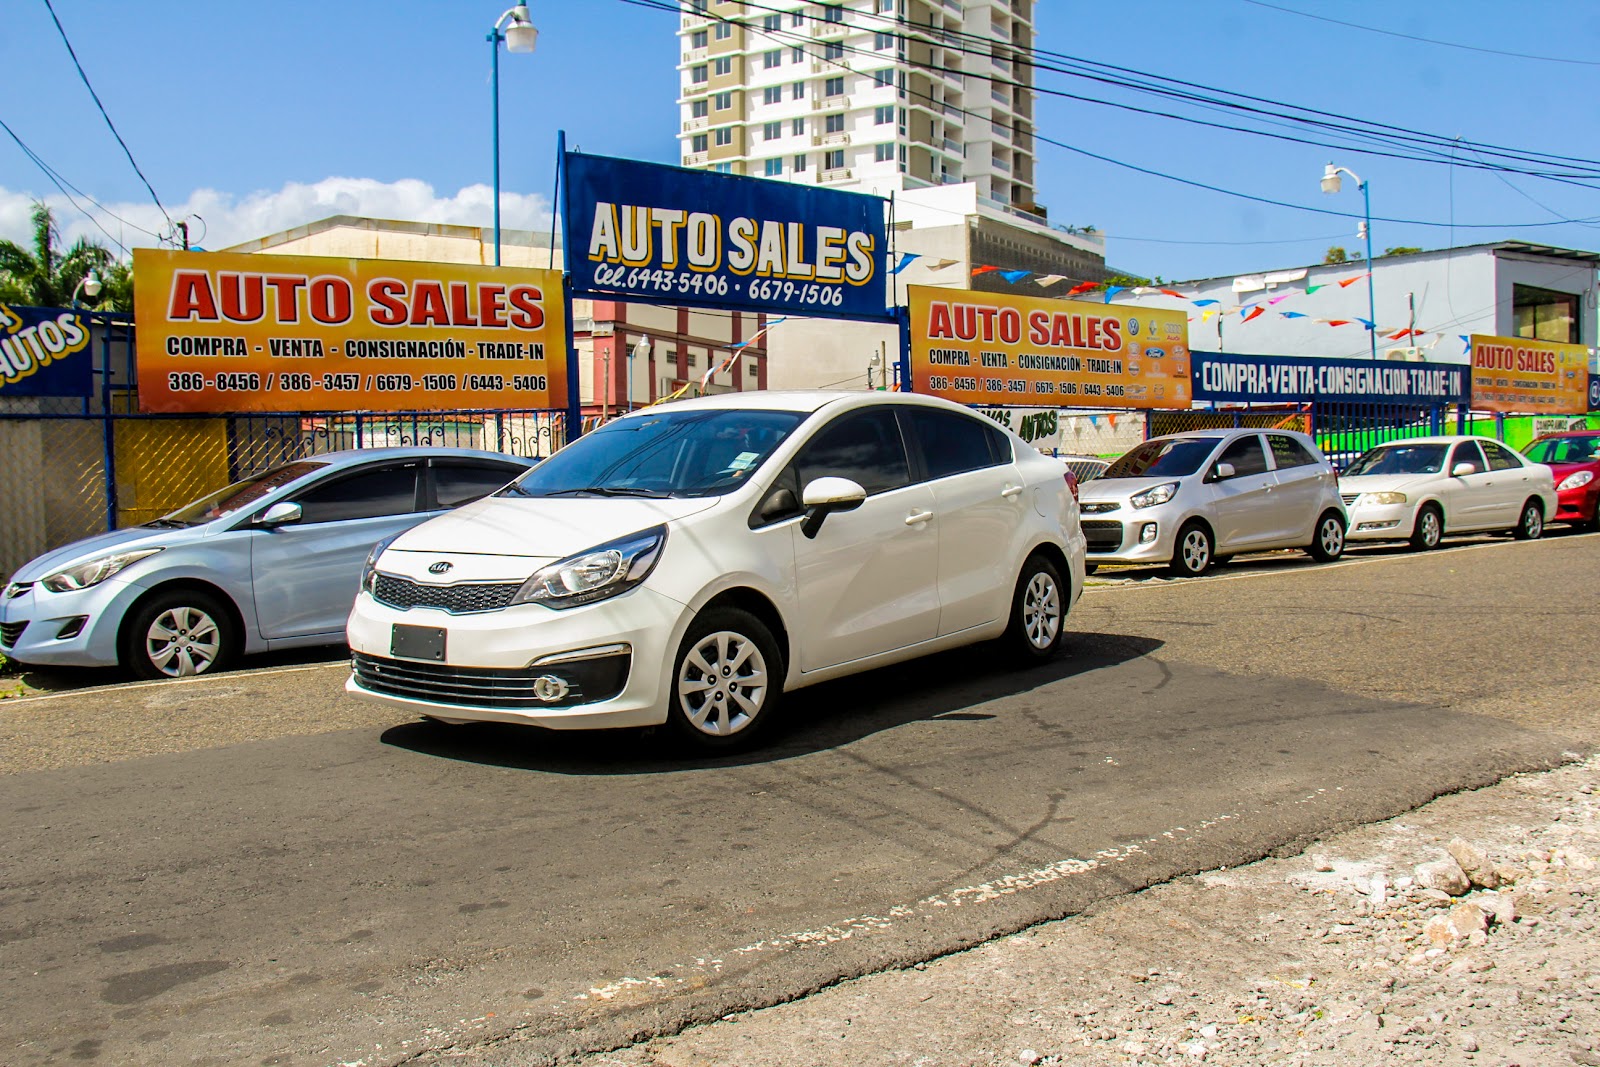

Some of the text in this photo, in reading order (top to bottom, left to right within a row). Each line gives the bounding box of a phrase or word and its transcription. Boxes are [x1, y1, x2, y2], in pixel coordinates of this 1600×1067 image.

[589, 202, 873, 286] AUTO SALES
[169, 268, 545, 329] AUTO SALES
[750, 279, 843, 306] 6679-1506
[928, 301, 1122, 352] AUTO SALES
[167, 337, 248, 356] COMPRA
[269, 339, 324, 357] VENTA
[345, 339, 465, 358] CONSIGNACIÓN
[477, 343, 544, 360] TRADE-IN
[930, 349, 970, 366] COMPRA
[981, 352, 1008, 368] VENTA
[1018, 354, 1081, 372] CONSIGNACIÓN
[1087, 358, 1122, 374] TRADE-IN
[1475, 345, 1555, 373] AUTO SALES
[1202, 361, 1461, 397] COMPRA VENTA CONSIGNACION TRADE-IN
[1019, 410, 1057, 443] AUTOS
[430, 562, 448, 571] KIA
